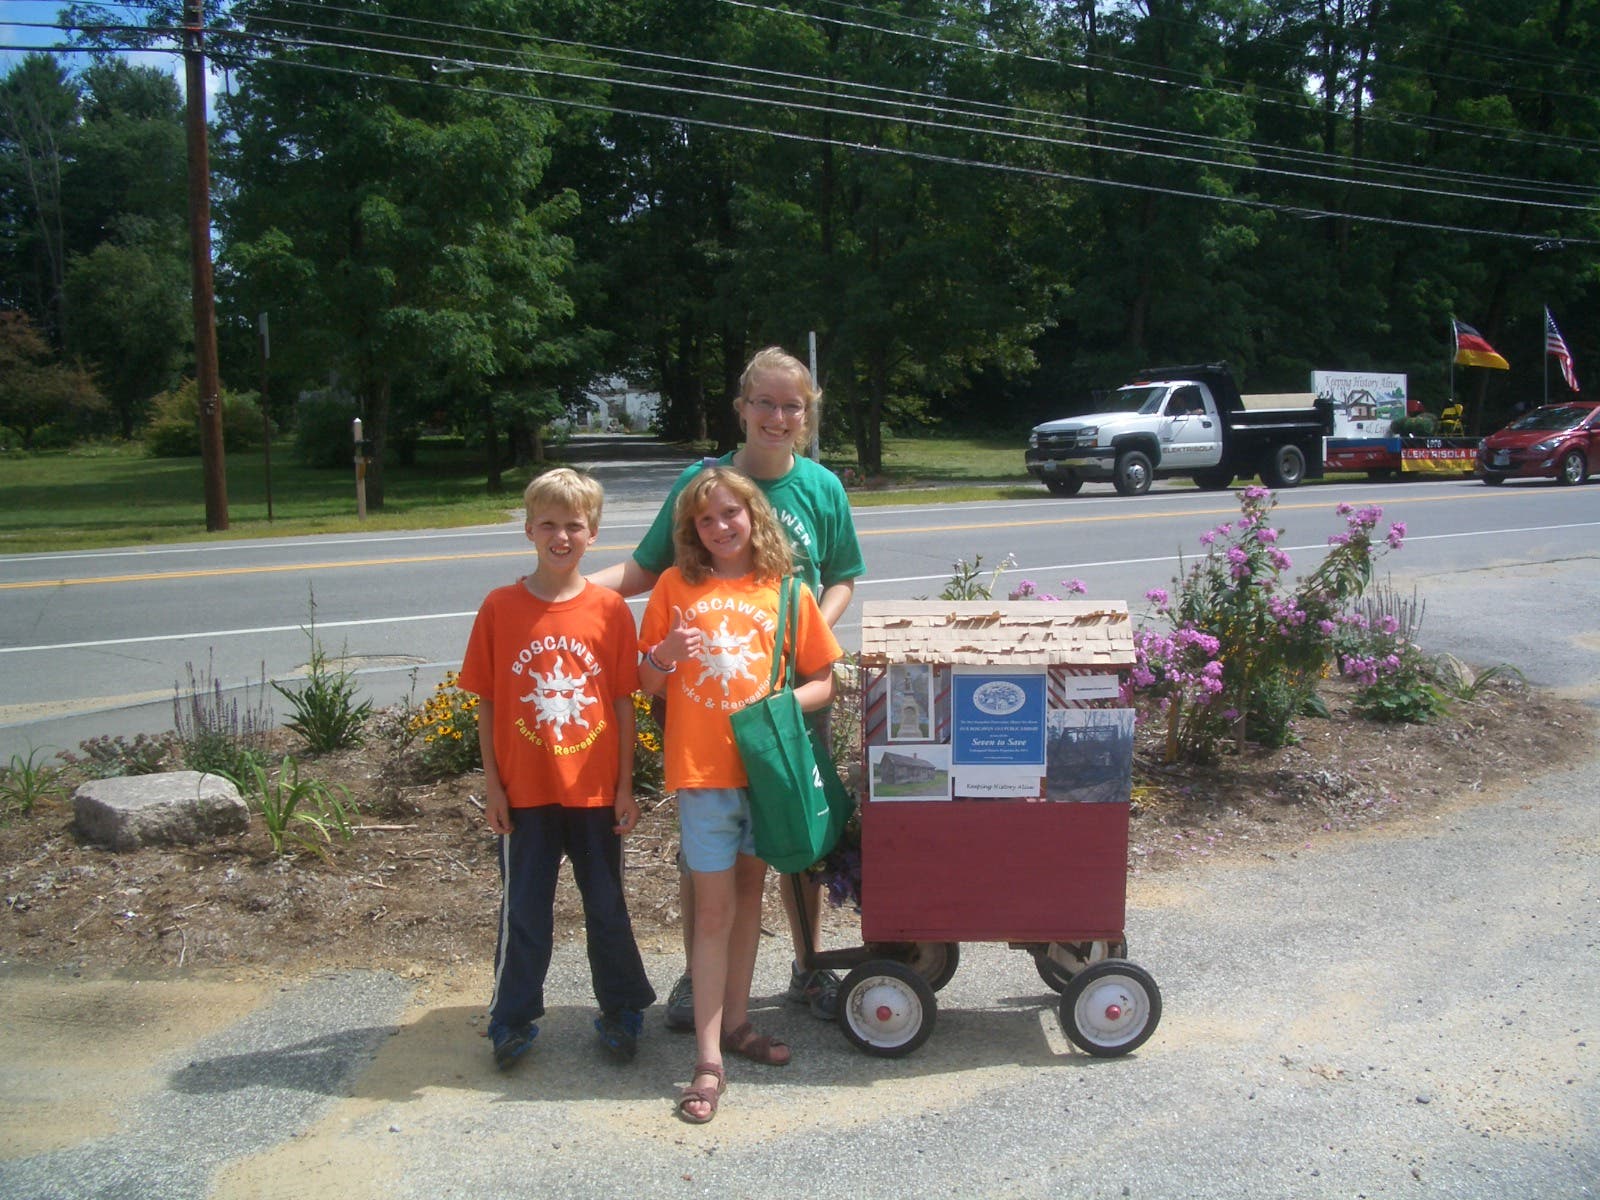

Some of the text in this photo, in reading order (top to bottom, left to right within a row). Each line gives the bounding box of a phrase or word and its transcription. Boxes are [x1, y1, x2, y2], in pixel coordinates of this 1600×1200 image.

[1352, 376, 1378, 390] History
[1162, 445, 1215, 454] ELEKTRISOLA
[1401, 449, 1466, 459] ELEKTRISOLA
[772, 507, 811, 546] AWEN
[512, 636, 601, 675] BOSCAWEN
[705, 698, 715, 708] &
[515, 718, 606, 756] Parks Recreation
[971, 737, 1027, 746] Seven to Save
